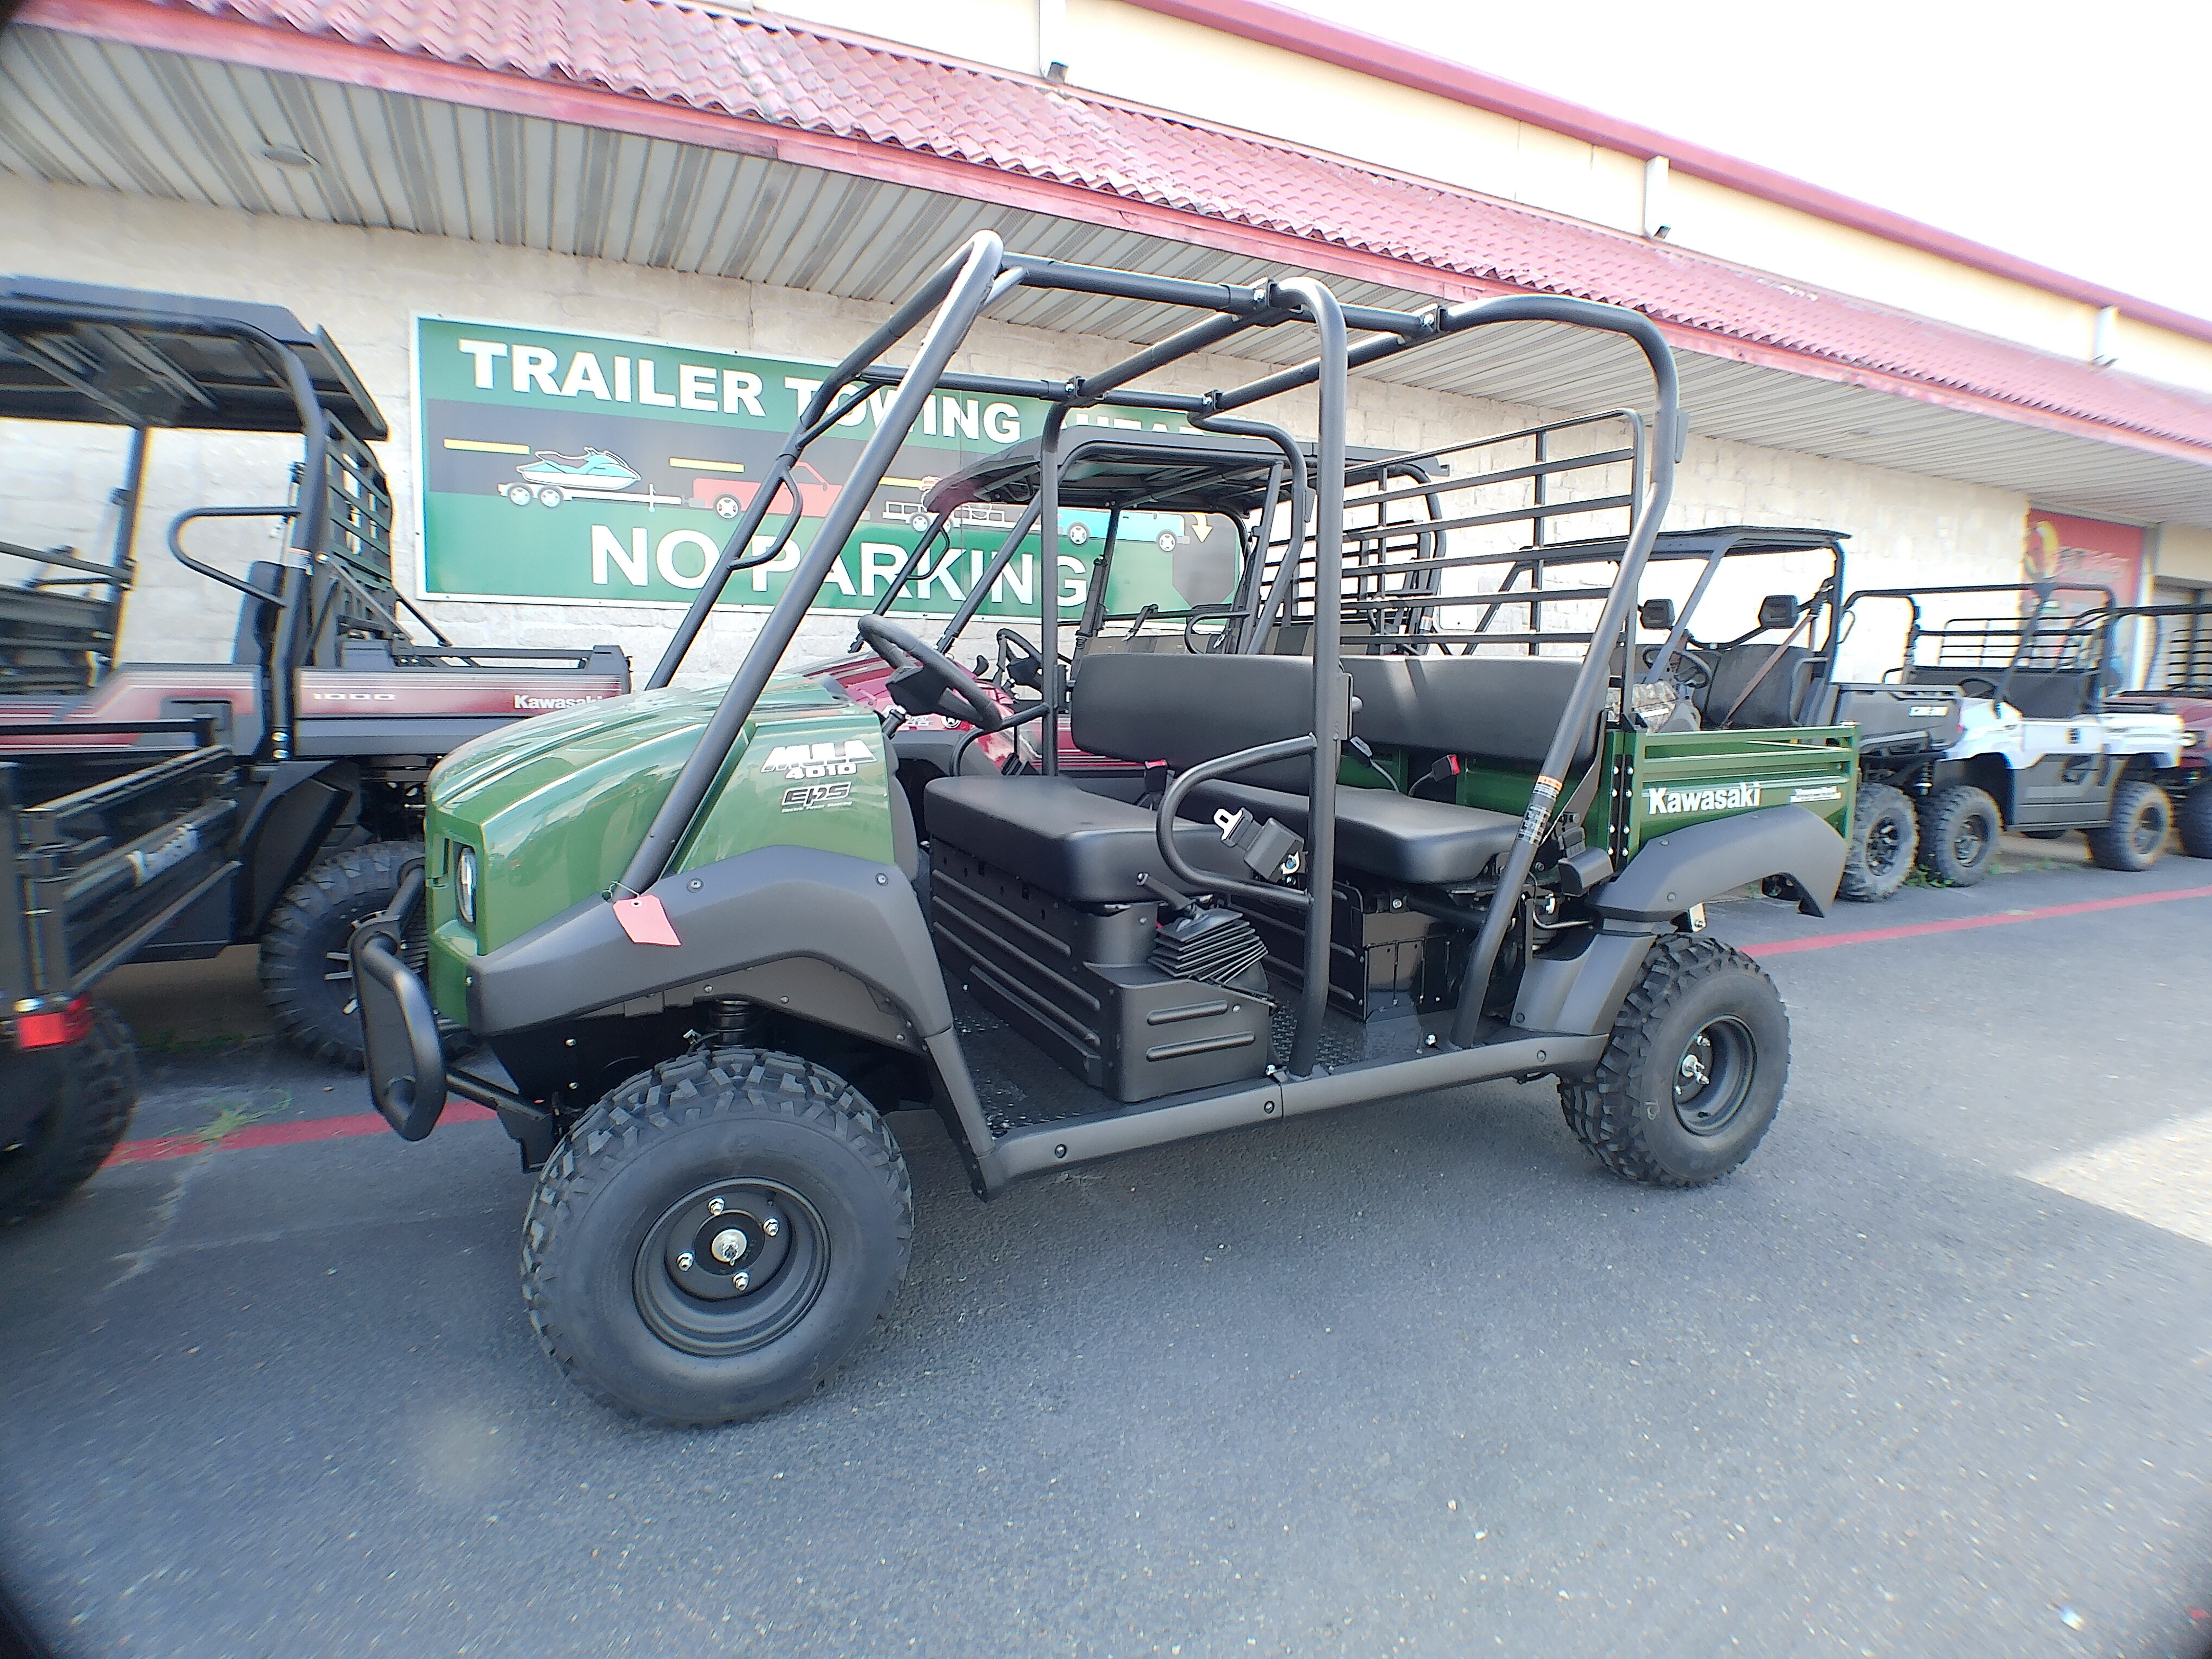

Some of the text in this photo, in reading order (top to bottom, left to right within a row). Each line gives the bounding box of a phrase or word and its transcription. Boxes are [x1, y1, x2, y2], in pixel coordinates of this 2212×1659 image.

[459, 338, 766, 417] TRAILER
[591, 524, 1087, 607] NO PARKING
[514, 695, 603, 709] Kawasak
[785, 763, 857, 779] 4010
[781, 782, 852, 807] EPS
[1648, 781, 1761, 815] Kawasaki
